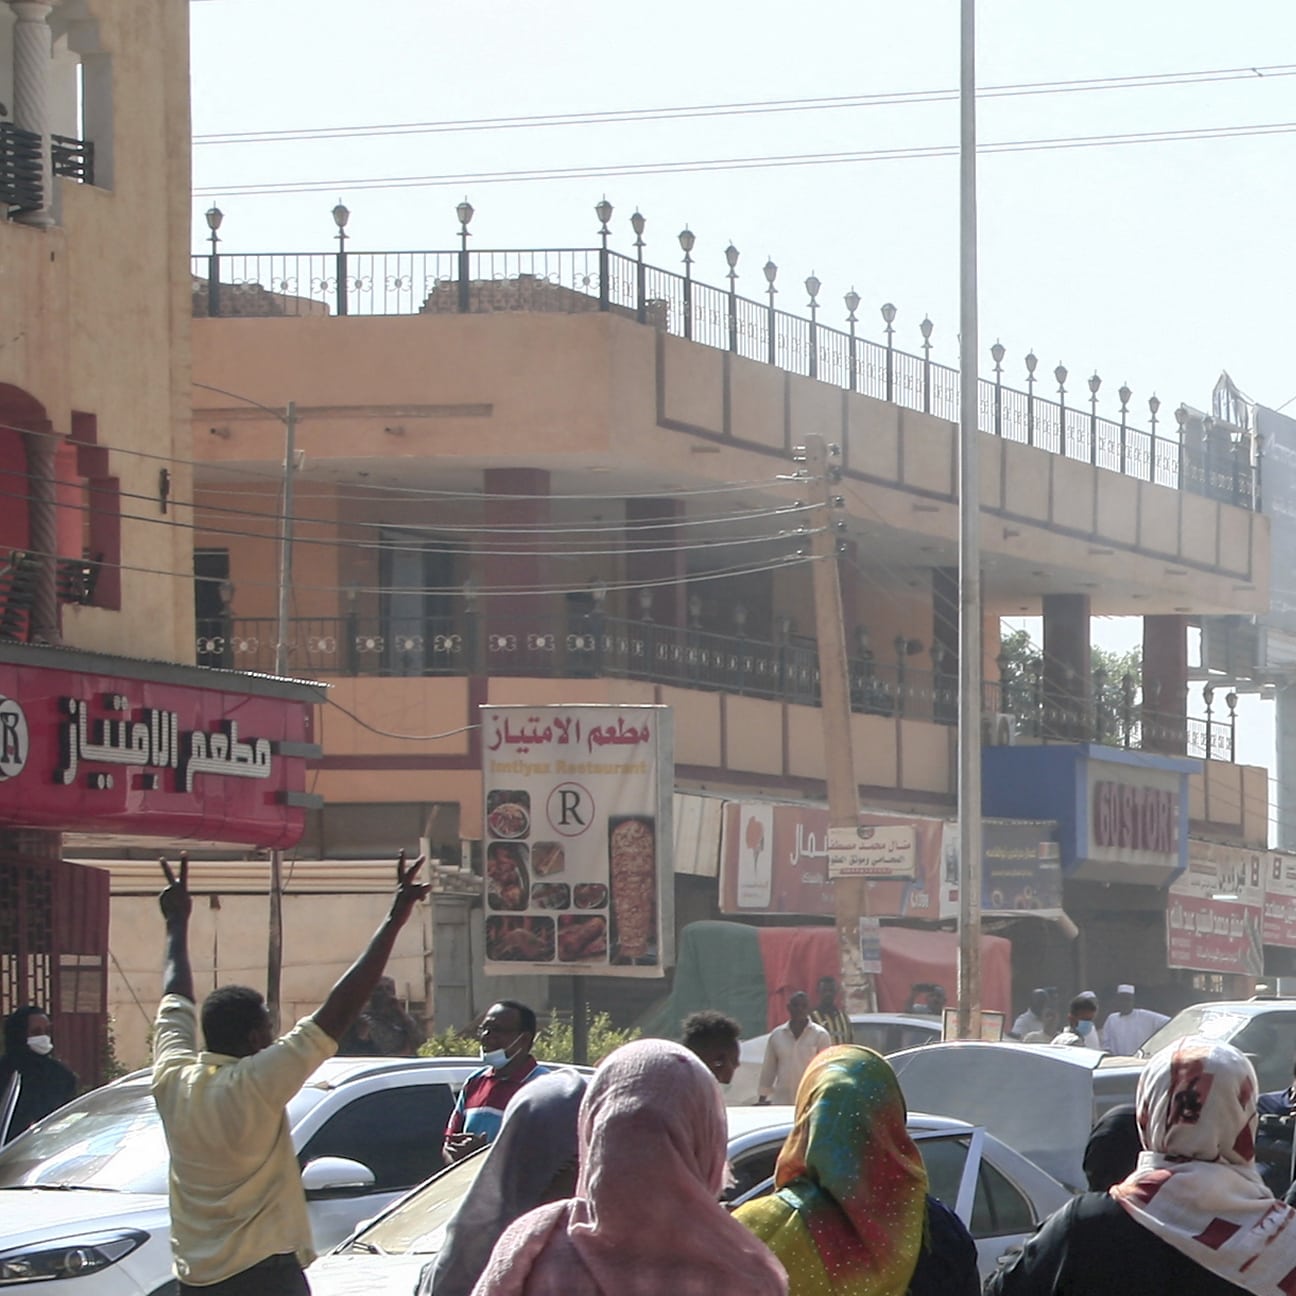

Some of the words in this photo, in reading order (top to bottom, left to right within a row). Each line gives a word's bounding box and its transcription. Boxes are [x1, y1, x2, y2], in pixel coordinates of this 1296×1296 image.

[0, 711, 23, 764] R
[185, 720, 271, 793] مطعم
[587, 715, 650, 754] مطعم
[528, 790, 556, 826] R
